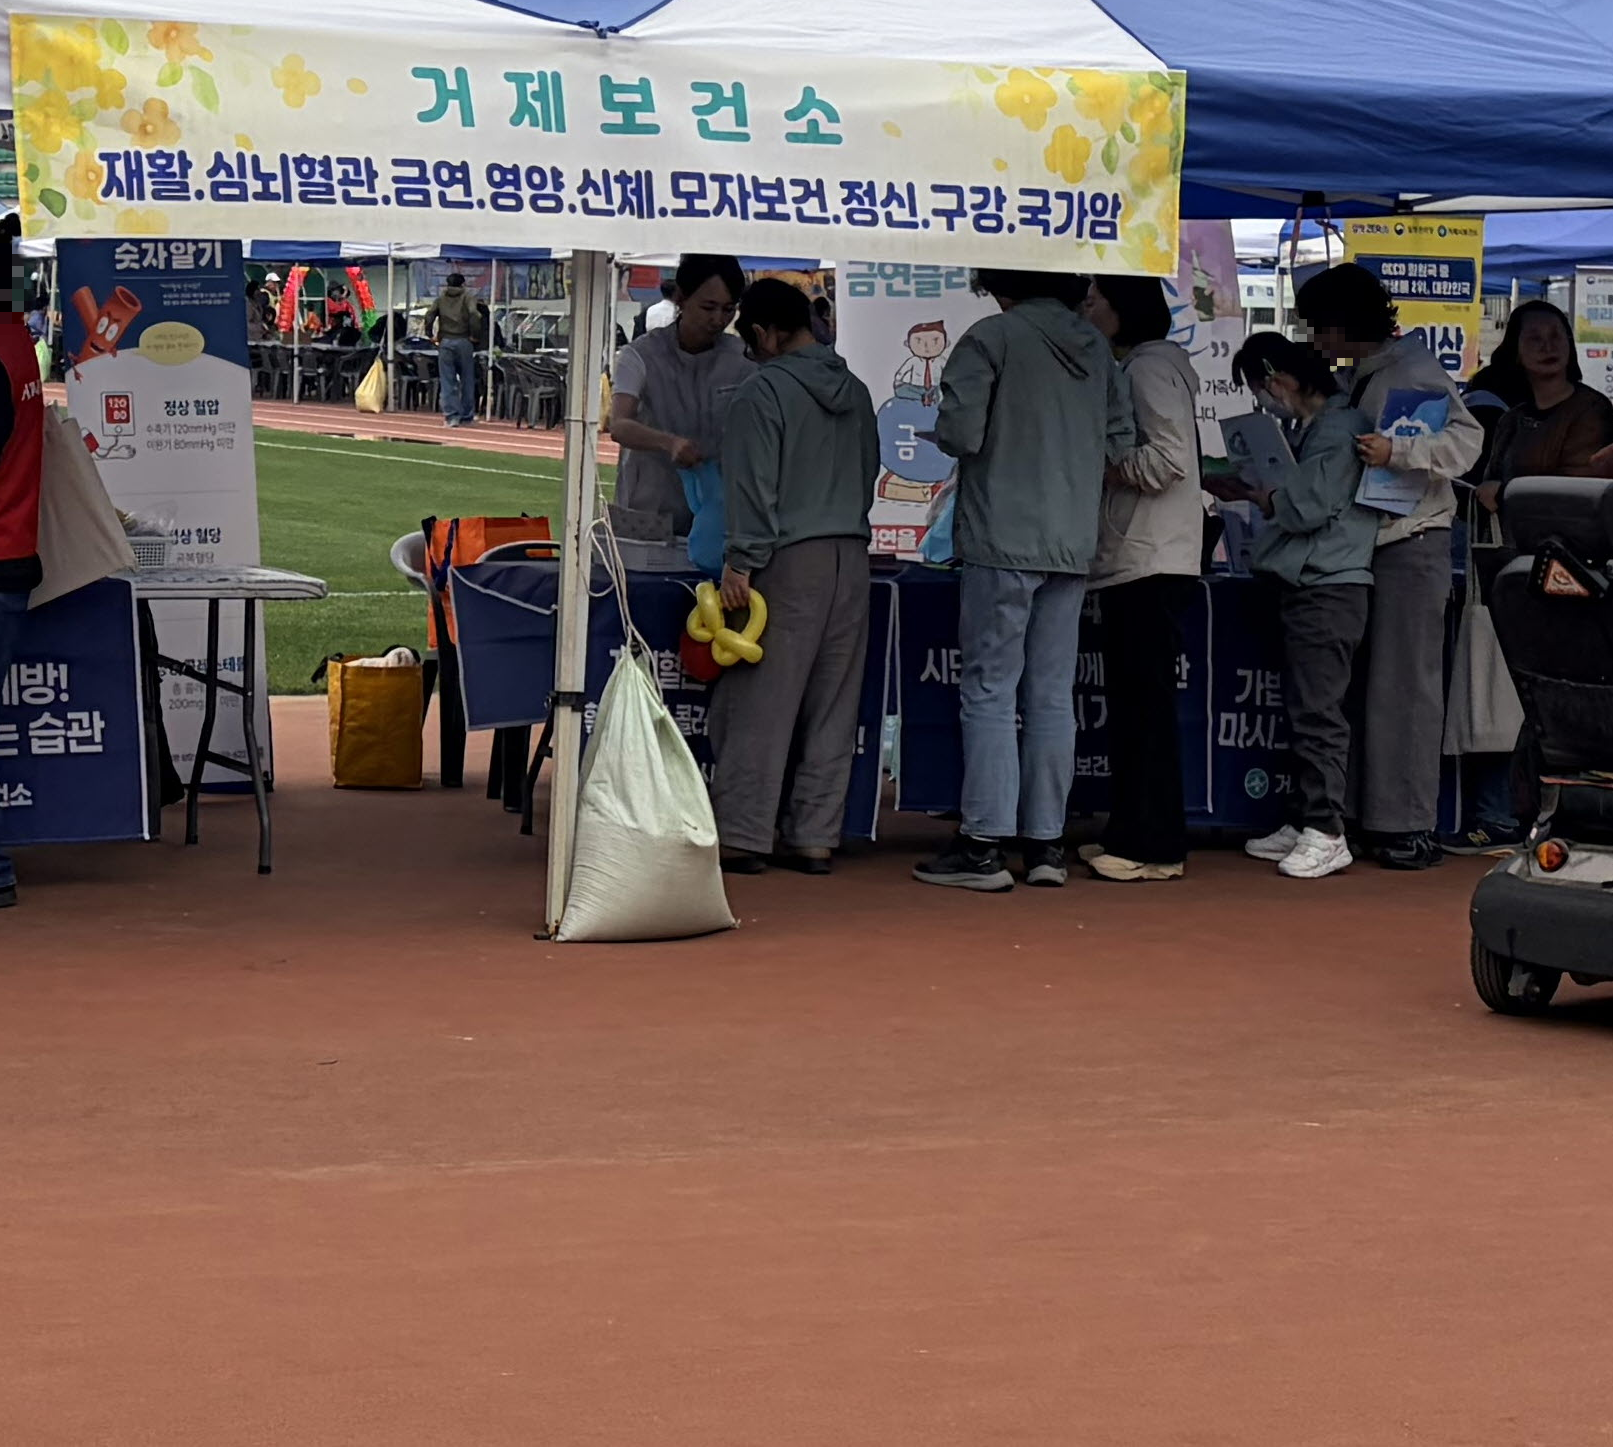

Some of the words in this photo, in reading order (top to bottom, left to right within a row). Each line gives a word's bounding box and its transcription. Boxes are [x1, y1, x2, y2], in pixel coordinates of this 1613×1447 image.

[114, 241, 224, 270] 숫자알기
[164, 400, 190, 417] 정상
[193, 399, 220, 416] 혈압
[894, 423, 919, 462] 금
[196, 527, 222, 544] 혈당
[28, 710, 106, 755] 습관
